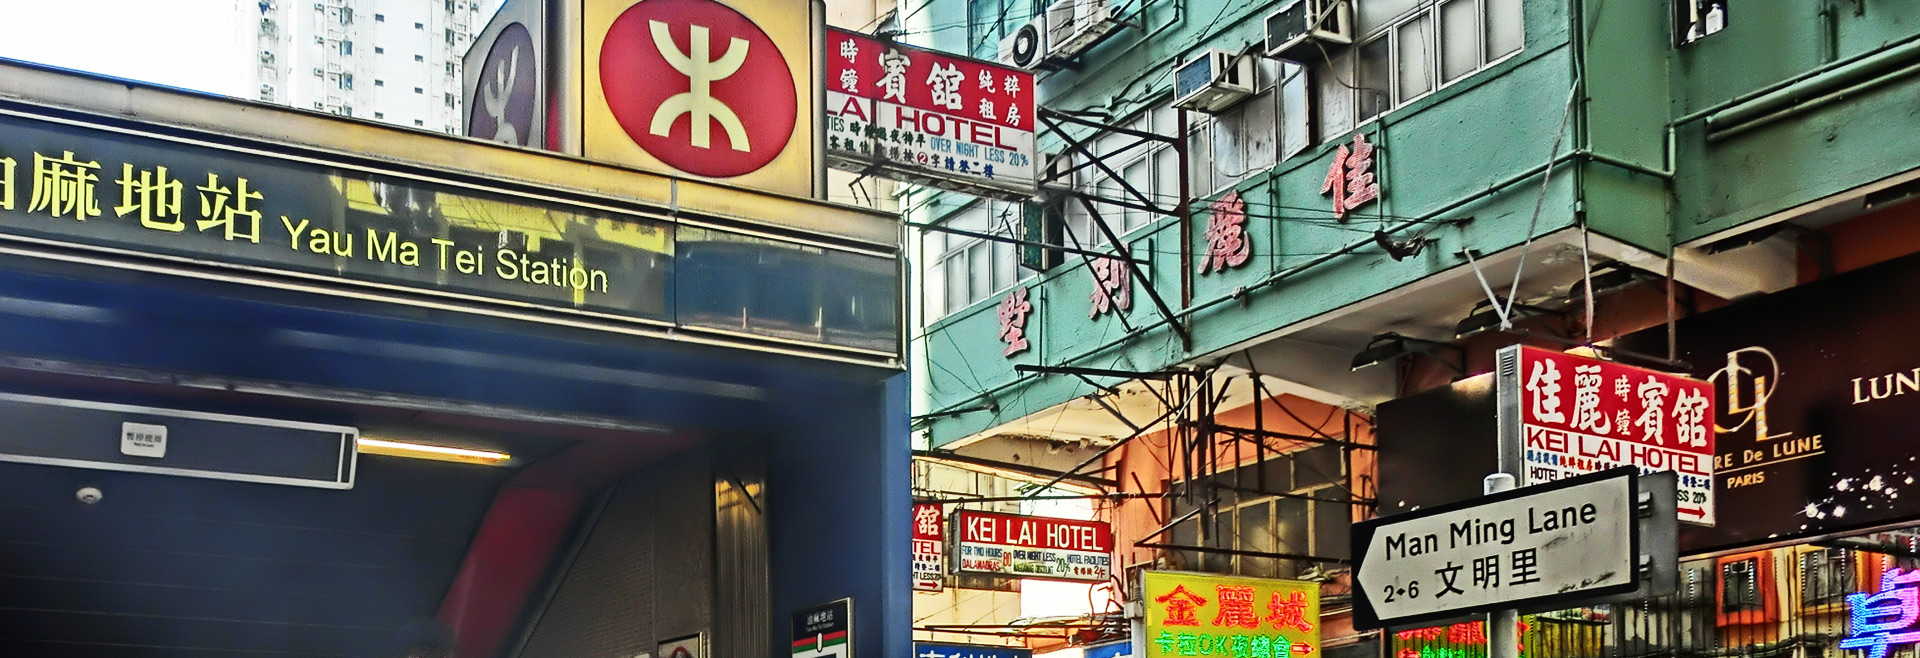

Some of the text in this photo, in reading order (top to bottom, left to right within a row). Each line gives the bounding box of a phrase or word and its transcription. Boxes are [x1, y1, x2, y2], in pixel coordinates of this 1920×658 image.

[896, 107, 1017, 151] HOTEL
[931, 137, 951, 153] OVER
[956, 141, 979, 158] NIGHT
[985, 147, 1005, 164] LESS
[1009, 152, 1029, 168] 20%
[280, 215, 608, 293] Yau Ma Tei Station
[1527, 427, 1710, 476] KEI LAI HOTEL
[1714, 435, 1823, 469] RE De LUNE
[1530, 466, 1558, 482] HOTEL
[1727, 472, 1765, 489] PARIS
[967, 516, 1104, 551] KEI LAI HOTEL
[1385, 502, 1597, 560] Man Ming Lane
[974, 547, 984, 557] TWO
[986, 548, 1003, 558] HOURS
[1043, 552, 1056, 562] LESS
[1067, 554, 1082, 564] HOTEL
[1435, 547, 1541, 599] 文明里
[1155, 584, 1313, 634] 金麗城
